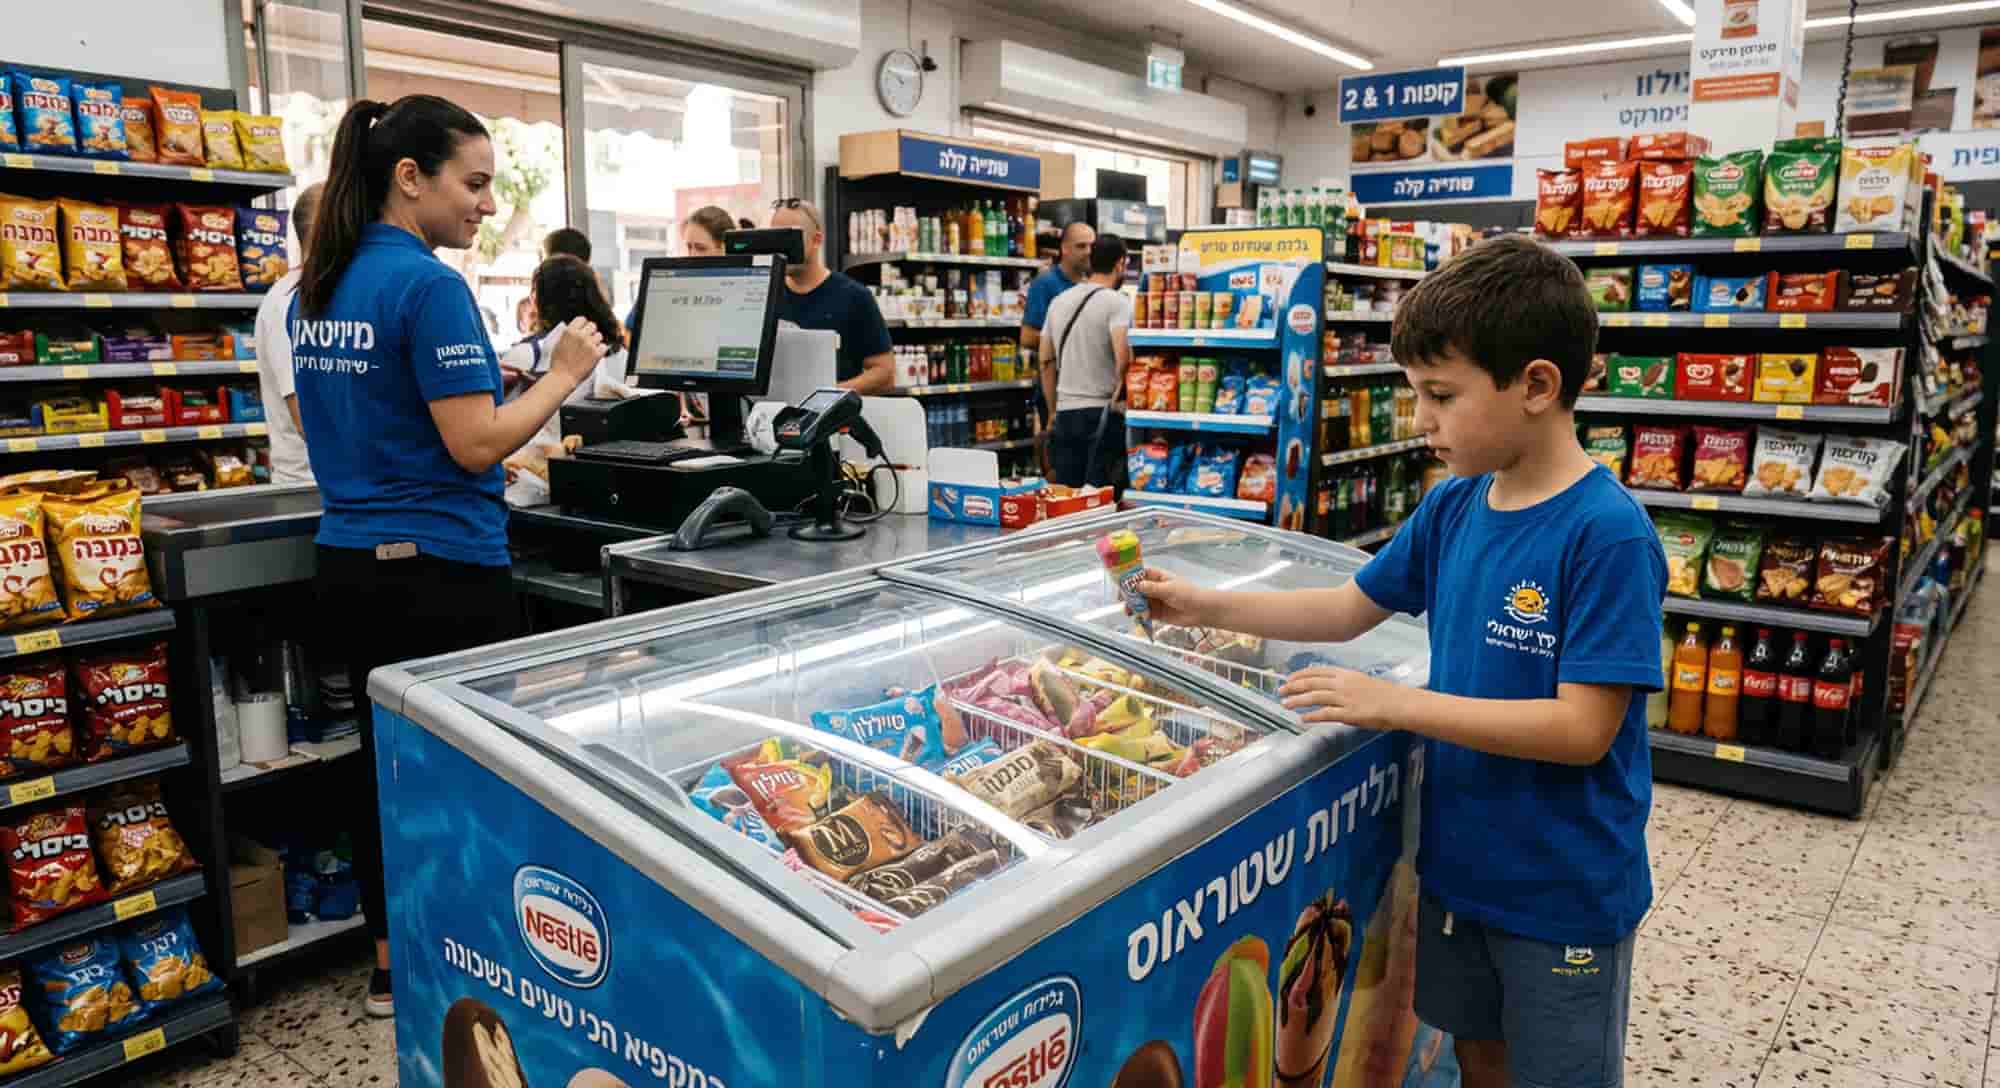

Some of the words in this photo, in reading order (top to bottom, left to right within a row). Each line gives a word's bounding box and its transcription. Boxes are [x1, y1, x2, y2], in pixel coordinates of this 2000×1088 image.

[1343, 90, 1360, 111] 2
[1361, 86, 1378, 109] &
[1383, 85, 1395, 107] 1
[939, 148, 967, 174] קלה
[1393, 179, 1425, 199] קלה
[74, 537, 144, 562] במבה
[1303, 762, 1400, 865] גלידות
[1128, 827, 1297, 981] שטוראוס
[443, 937, 516, 998] בשכונה
[519, 977, 575, 1028] טעים
[579, 1008, 618, 1053] הכי
